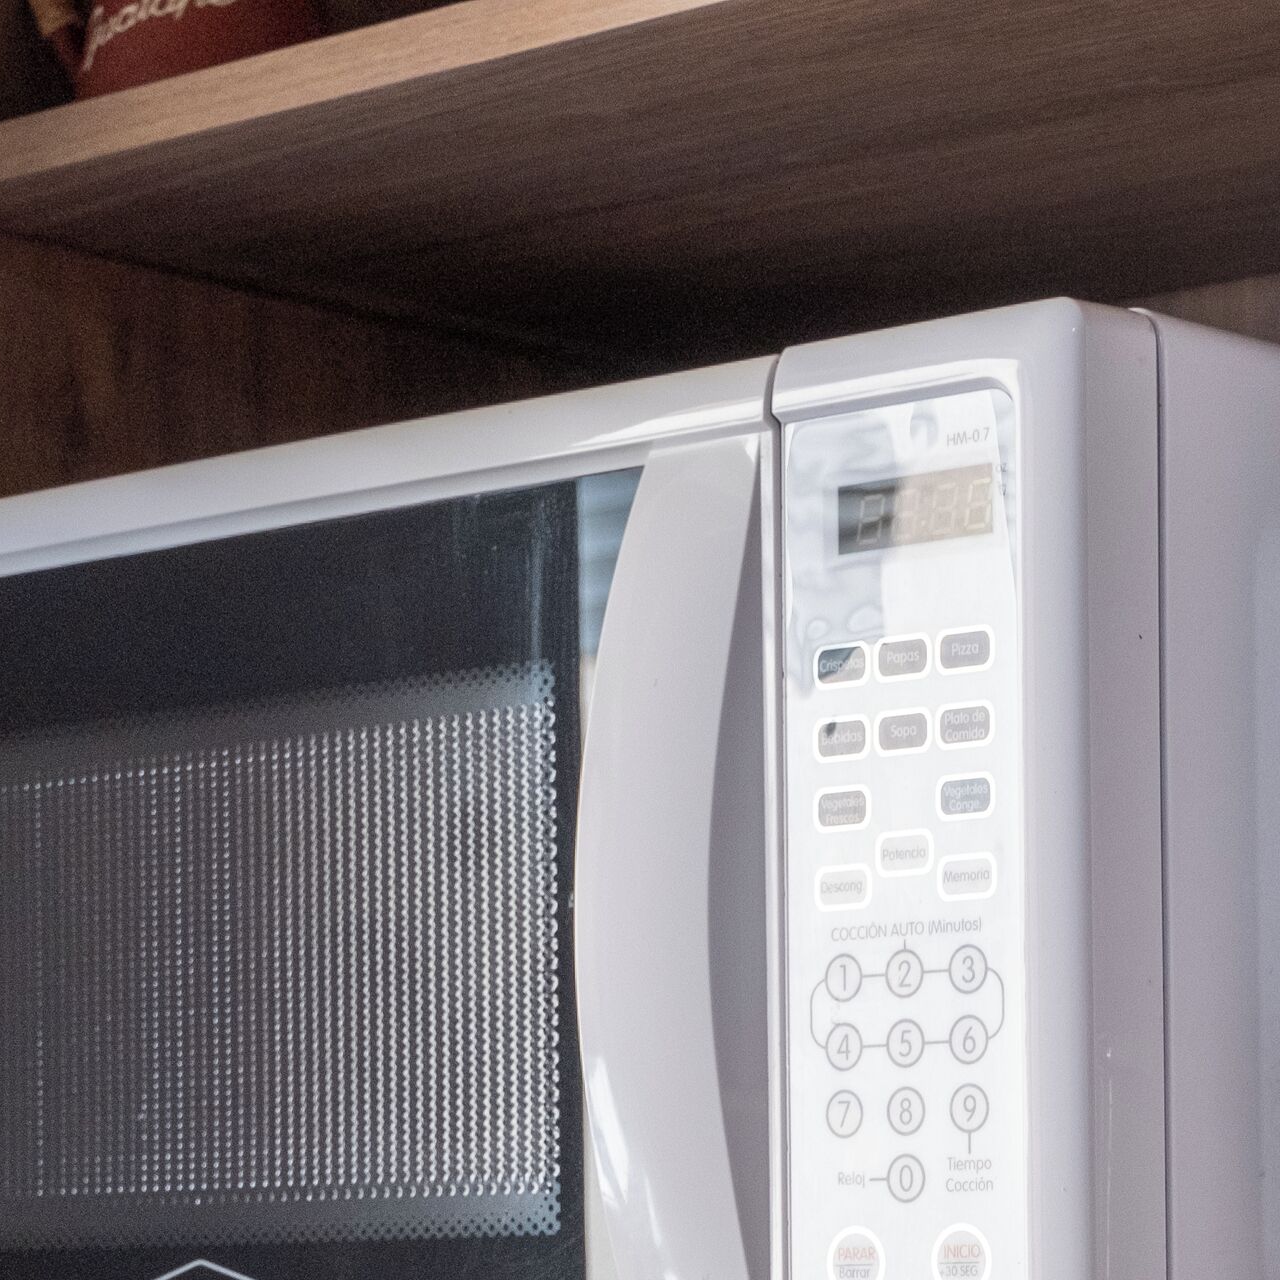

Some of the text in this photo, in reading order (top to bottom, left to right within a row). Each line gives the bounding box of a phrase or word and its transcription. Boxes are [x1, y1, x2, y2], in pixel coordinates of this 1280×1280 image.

[886, 649, 920, 667] Papas
[951, 641, 980, 657] Pizza
[972, 709, 986, 722] de
[890, 724, 918, 740] Sopa
[882, 845, 926, 861] Potencia
[943, 868, 990, 883] Memoria
[831, 916, 982, 942] COCCIÓN AUTO (Minutos)
[898, 960, 912, 988] 2
[961, 955, 975, 984] 3
[836, 1033, 851, 1060] 4
[898, 1030, 912, 1057] 5
[962, 1026, 976, 1054] 6
[837, 1100, 851, 1128] 7
[899, 1097, 913, 1125] 8
[963, 1094, 976, 1122] 9
[947, 1156, 992, 1175] Tiempo
[837, 1172, 865, 1189] Reloj
[899, 1164, 913, 1192] 0
[945, 1176, 994, 1193] Cocción
[943, 1243, 981, 1259] INICIO
